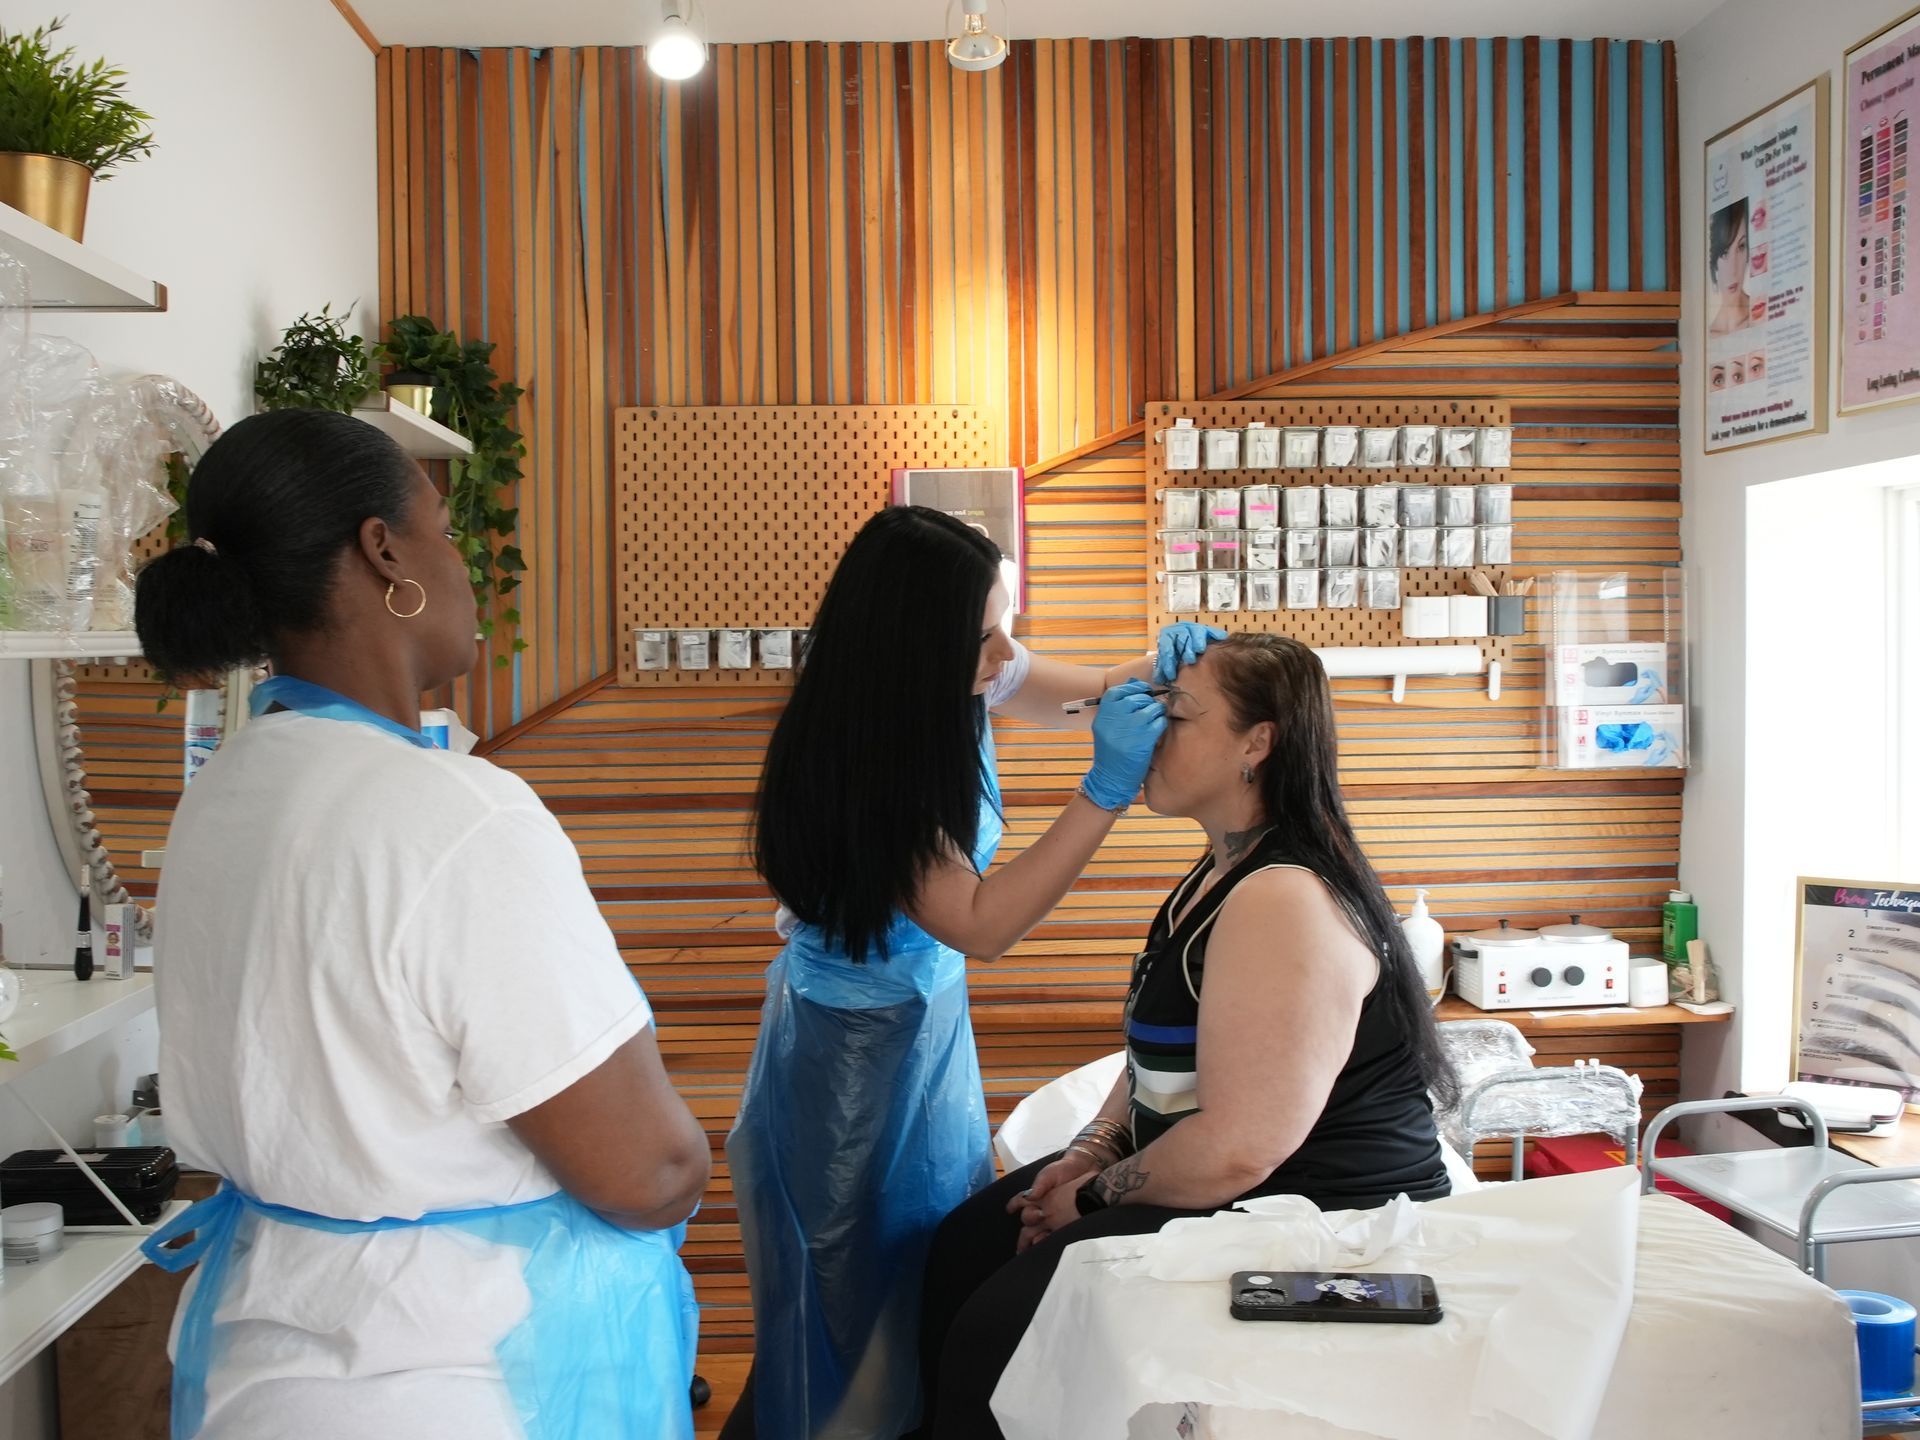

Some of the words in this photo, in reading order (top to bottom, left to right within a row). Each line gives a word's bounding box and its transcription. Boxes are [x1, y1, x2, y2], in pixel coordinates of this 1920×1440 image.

[1861, 52, 1905, 86] Permanent
[1834, 888, 1868, 906] Brow
[1863, 909, 1869, 918] 1
[1848, 929, 1856, 938] 2
[1836, 953, 1844, 963] 3
[1826, 976, 1833, 985] 4
[1812, 1001, 1819, 1010] 5
